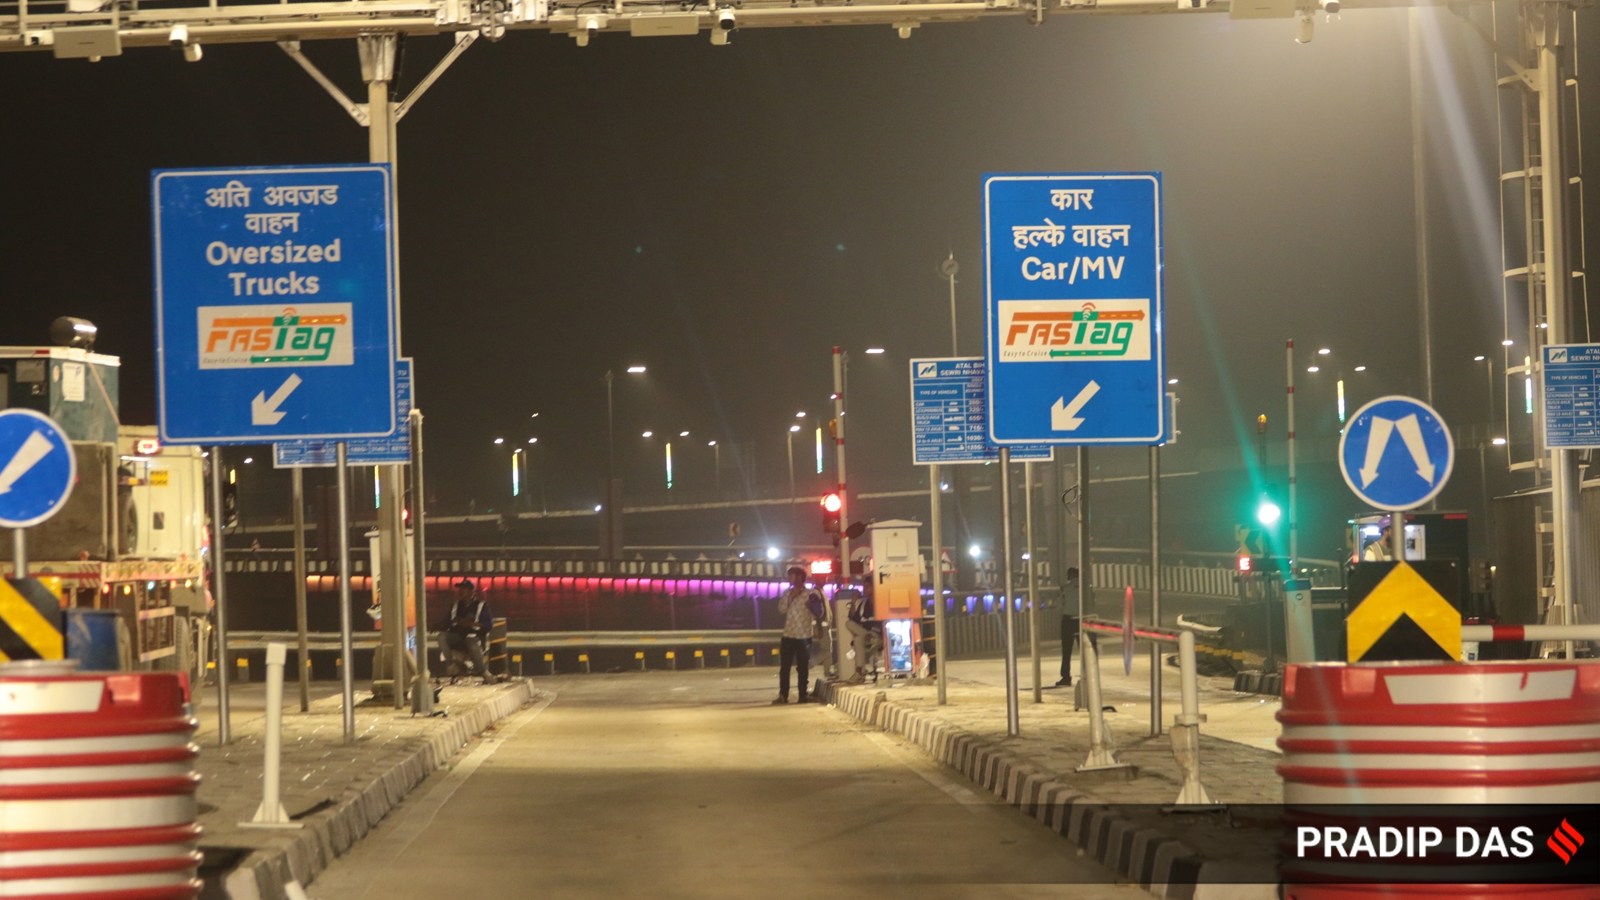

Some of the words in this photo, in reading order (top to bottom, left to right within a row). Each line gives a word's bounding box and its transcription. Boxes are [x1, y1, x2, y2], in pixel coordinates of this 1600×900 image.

[205, 180, 251, 208] अति
[263, 183, 339, 206] अवजड
[1050, 188, 1094, 210] कार
[245, 212, 300, 235] वाहन
[1012, 218, 1065, 249] हल्के
[1072, 224, 1131, 248] वाहन
[206, 239, 342, 266] Oversized
[229, 271, 320, 297] Trucks
[1021, 256, 1125, 285] Car/MV
